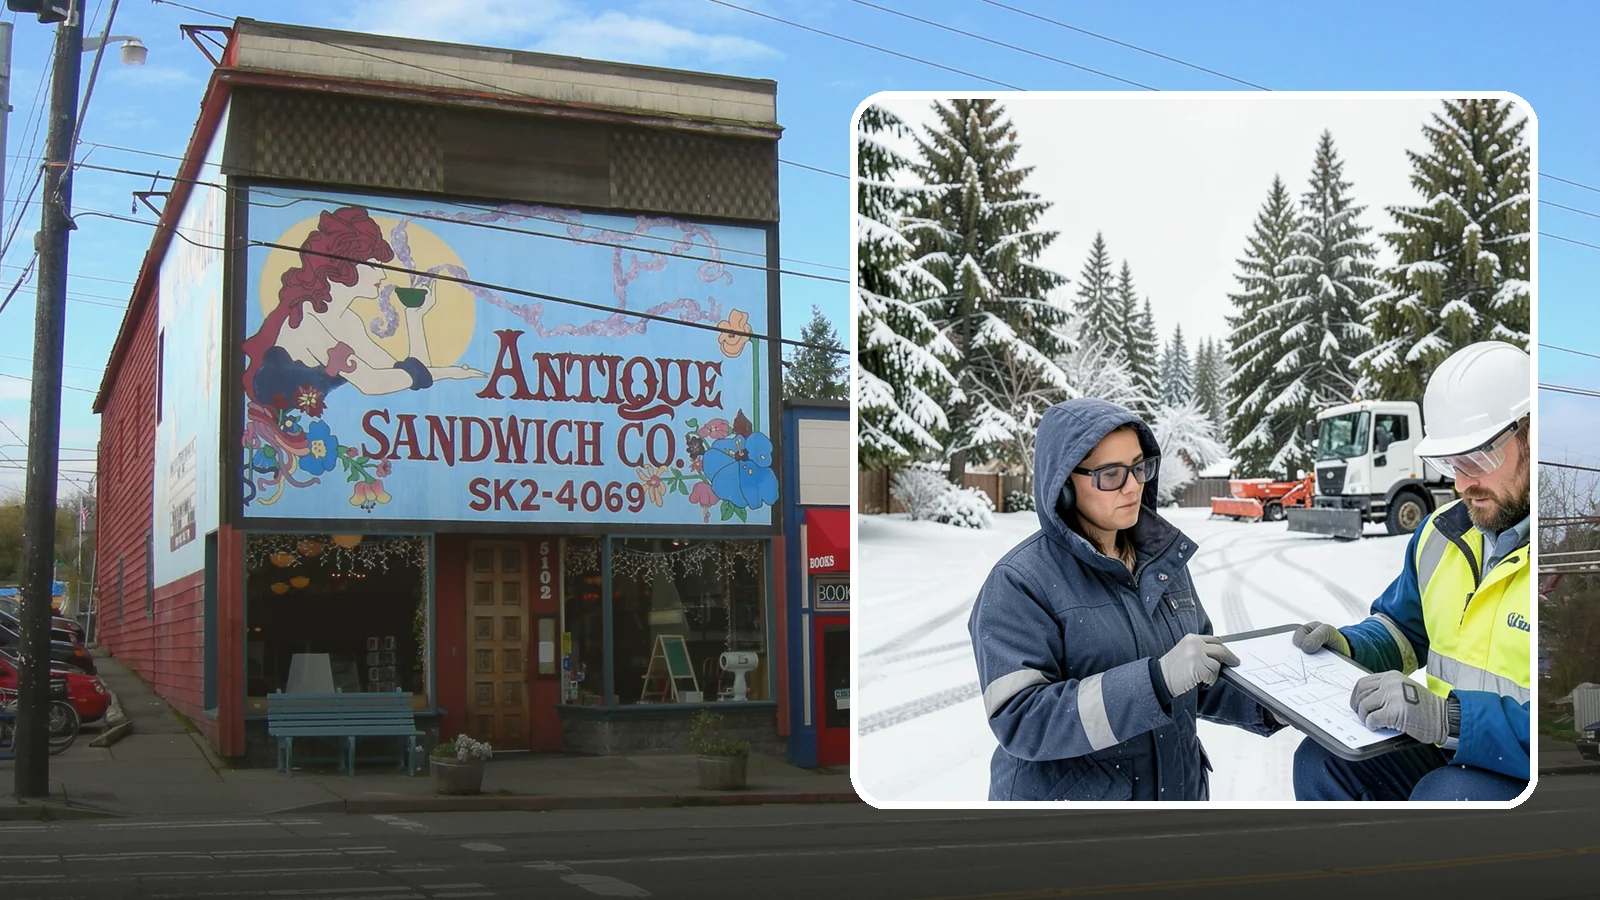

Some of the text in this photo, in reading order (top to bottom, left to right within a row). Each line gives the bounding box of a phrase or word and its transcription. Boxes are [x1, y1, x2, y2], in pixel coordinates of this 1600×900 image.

[476, 329, 723, 421] ANTIQUE
[360, 409, 686, 469] SANDWICH CO.
[468, 477, 646, 512] SK2-4069
[540, 541, 551, 599] 5102
[809, 555, 834, 569] BOOKS
